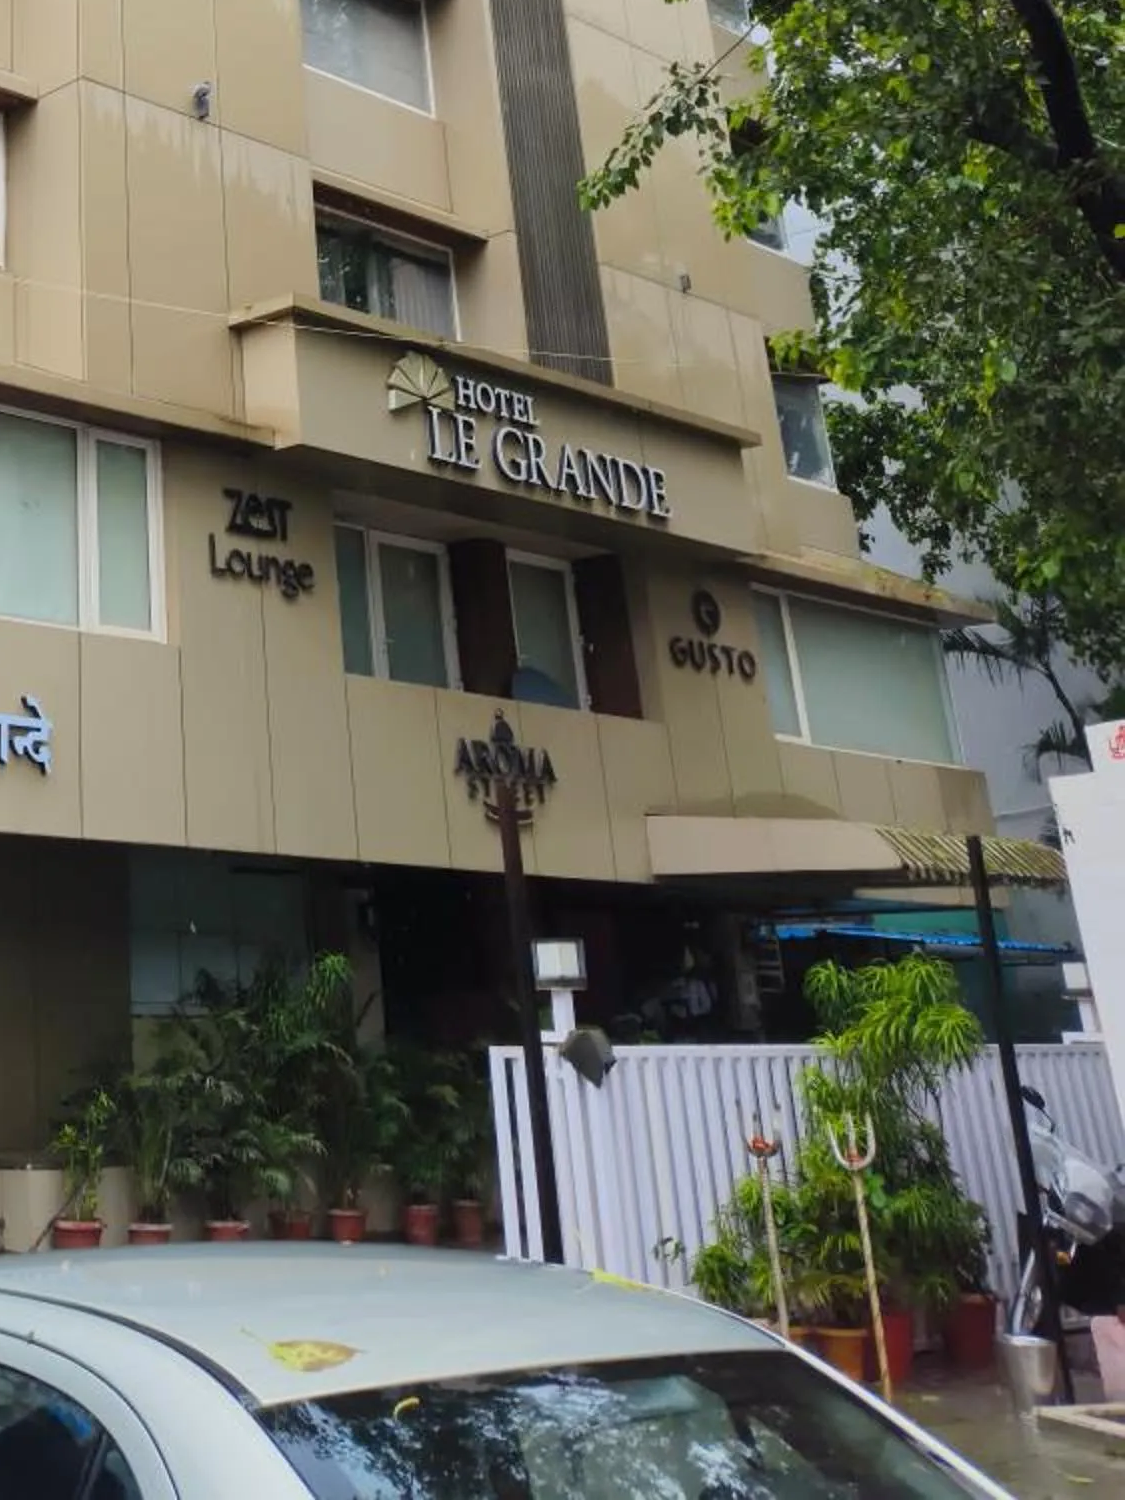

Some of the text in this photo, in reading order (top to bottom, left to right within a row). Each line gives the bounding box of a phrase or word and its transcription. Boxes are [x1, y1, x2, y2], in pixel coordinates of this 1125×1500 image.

[456, 376, 539, 425] HOTEL
[427, 406, 672, 518] LE GRANDE
[208, 532, 315, 599] Lounge
[669, 636, 756, 683] GUSTO
[454, 738, 557, 783] AROMA
